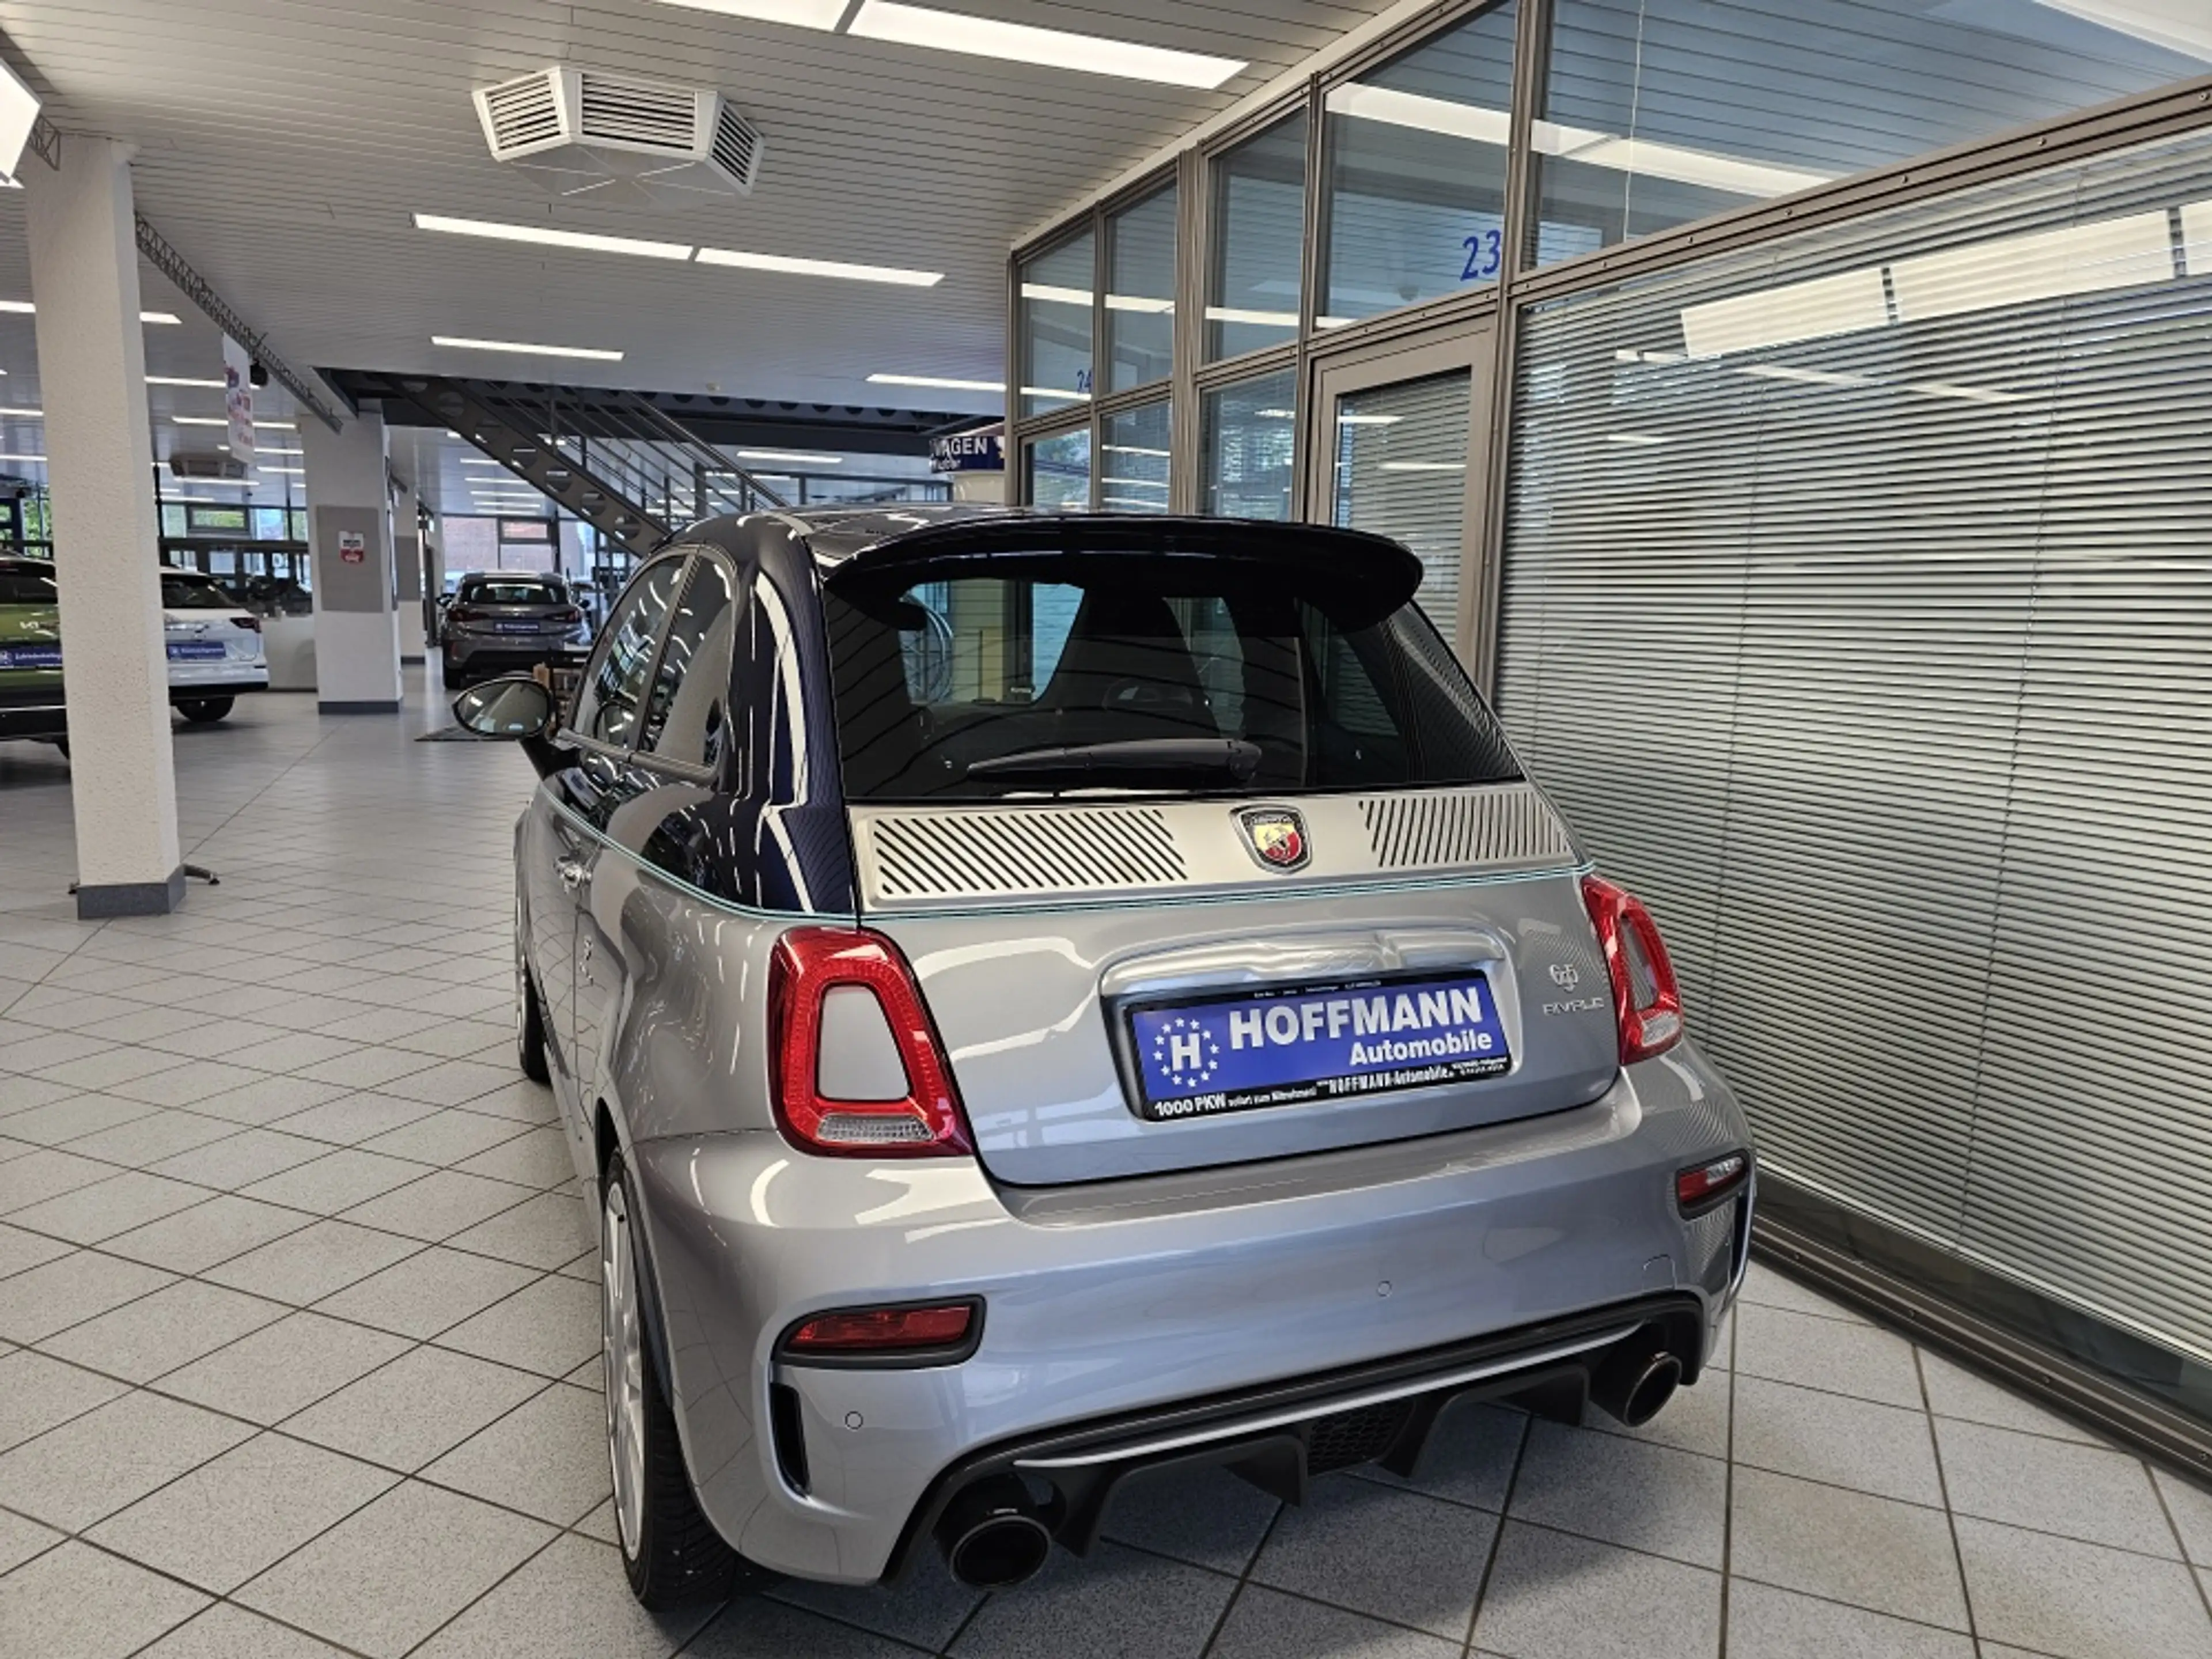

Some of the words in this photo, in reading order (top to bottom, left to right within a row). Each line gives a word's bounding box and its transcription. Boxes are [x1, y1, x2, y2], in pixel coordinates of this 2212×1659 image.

[1460, 230, 1501, 281] 23
[1229, 986, 1483, 1050] HOFFMANN
[1171, 1032, 1202, 1071] H
[1349, 1030, 1492, 1066] Automobile
[1154, 1099, 1194, 1116] 1000
[1194, 1093, 1226, 1112] PKW
